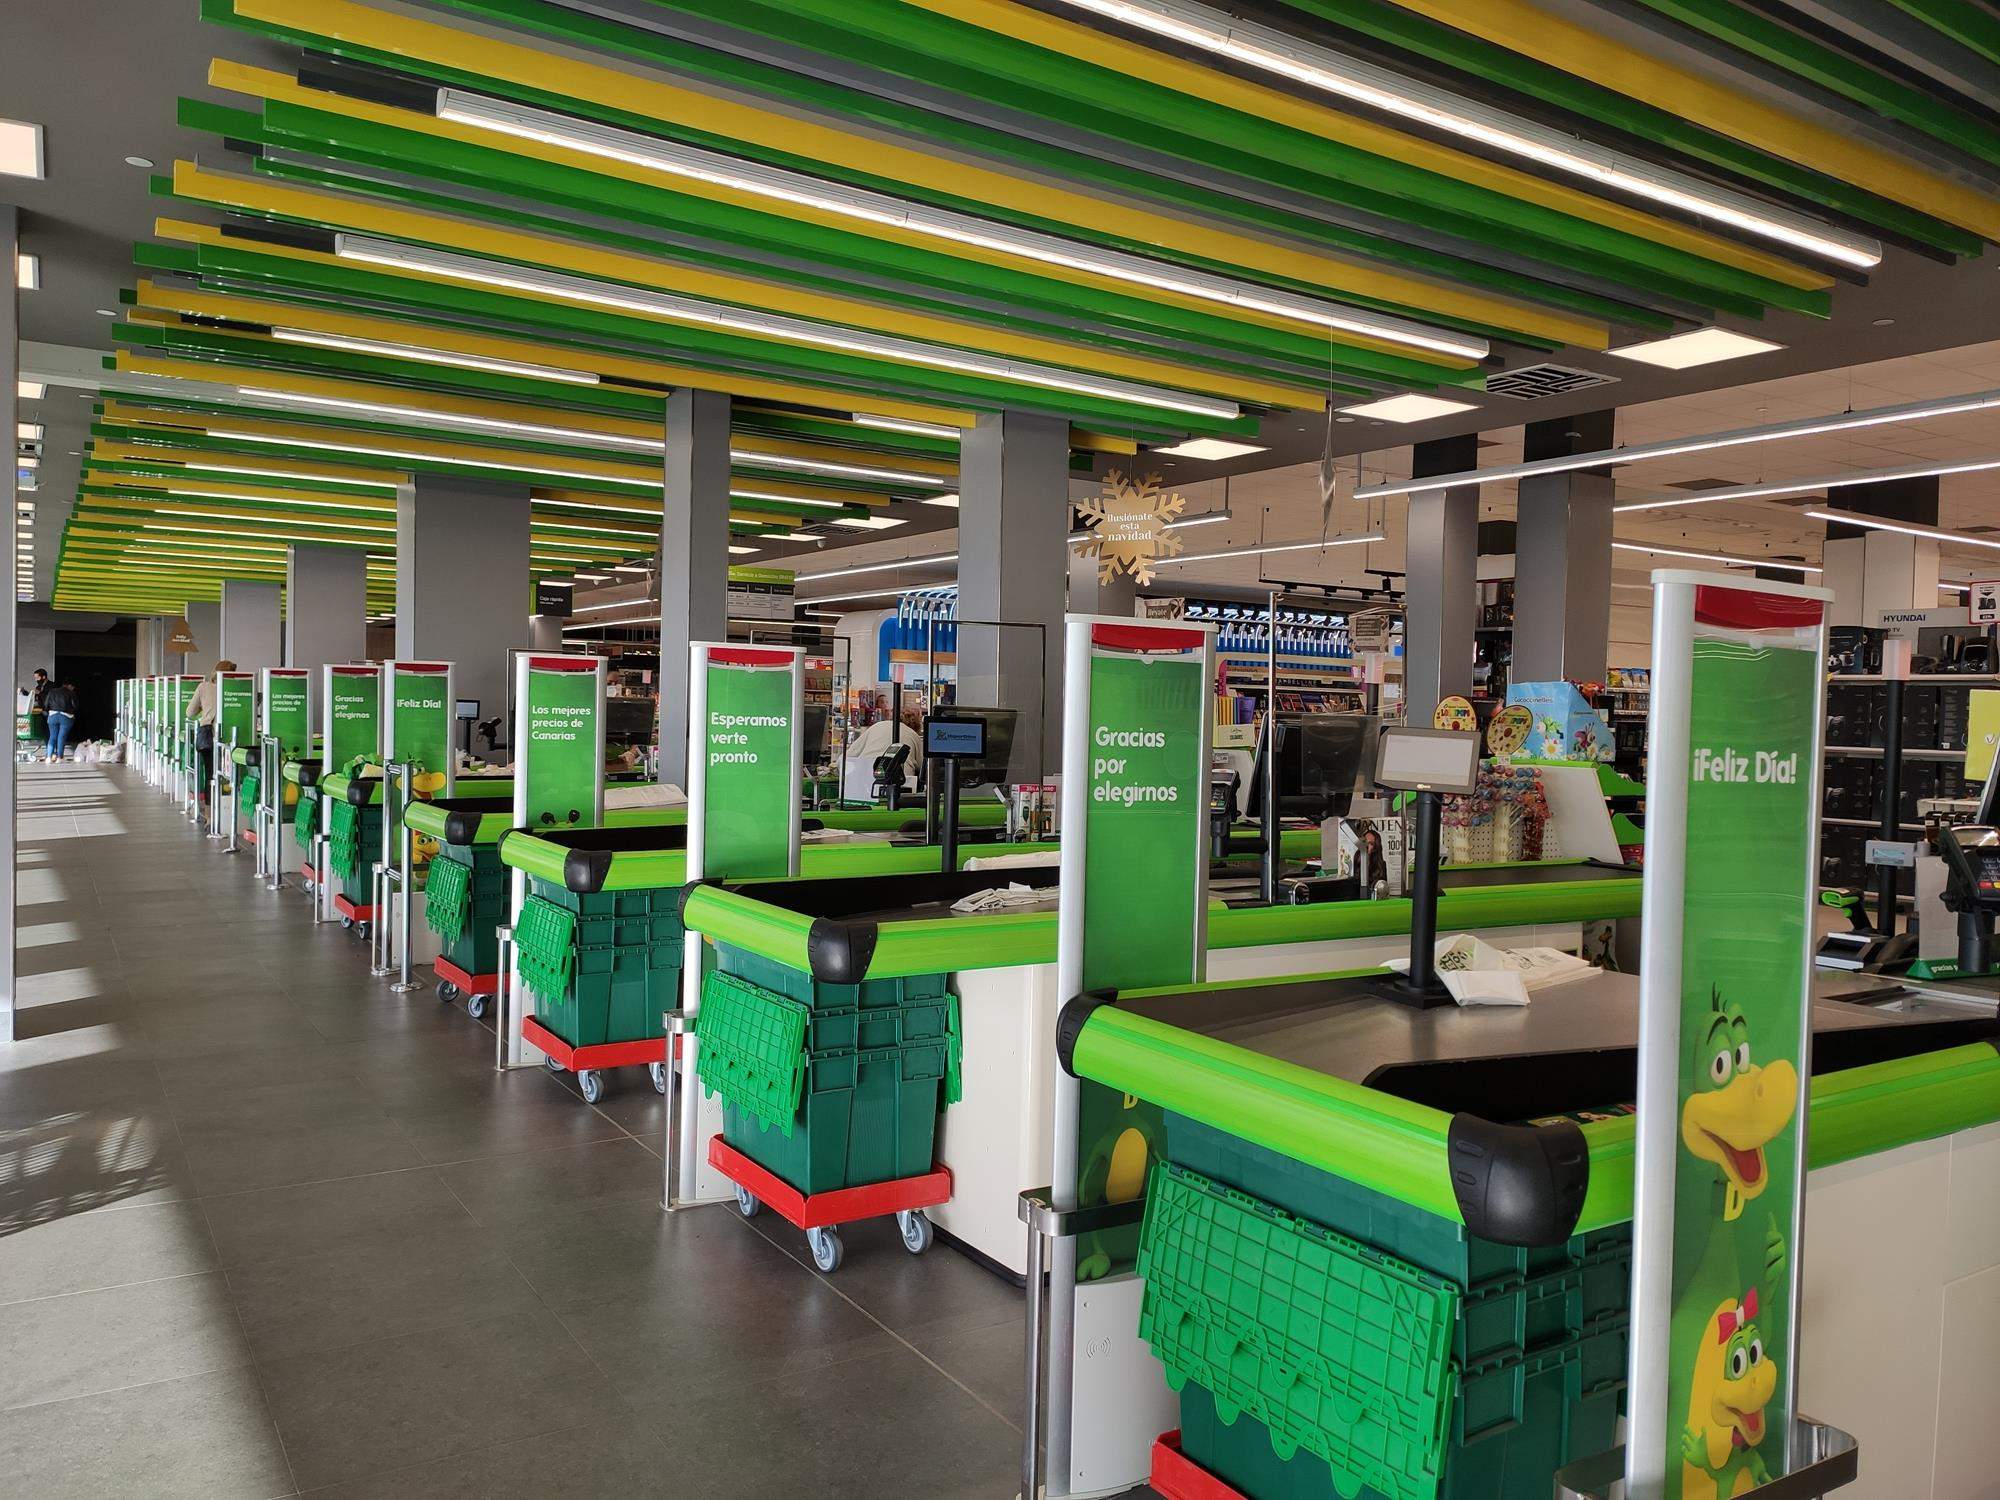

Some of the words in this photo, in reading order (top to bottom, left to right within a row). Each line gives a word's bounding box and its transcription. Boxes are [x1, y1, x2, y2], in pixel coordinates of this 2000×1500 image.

[1120, 522, 1139, 530] esta
[532, 705, 549, 714] Los
[552, 706, 591, 717] mejores
[532, 719, 568, 729] precios
[571, 719, 584, 727] de
[711, 712, 787, 728] Esperamos
[532, 731, 576, 740] Canarias
[711, 732, 748, 744] verte
[1095, 726, 1165, 748] Gracias
[710, 751, 758, 766] pronto
[1693, 747, 1748, 782] ¡Feliz
[1755, 751, 1797, 784] Día!
[1094, 758, 1127, 779] por
[1094, 780, 1177, 807] elegirnos
